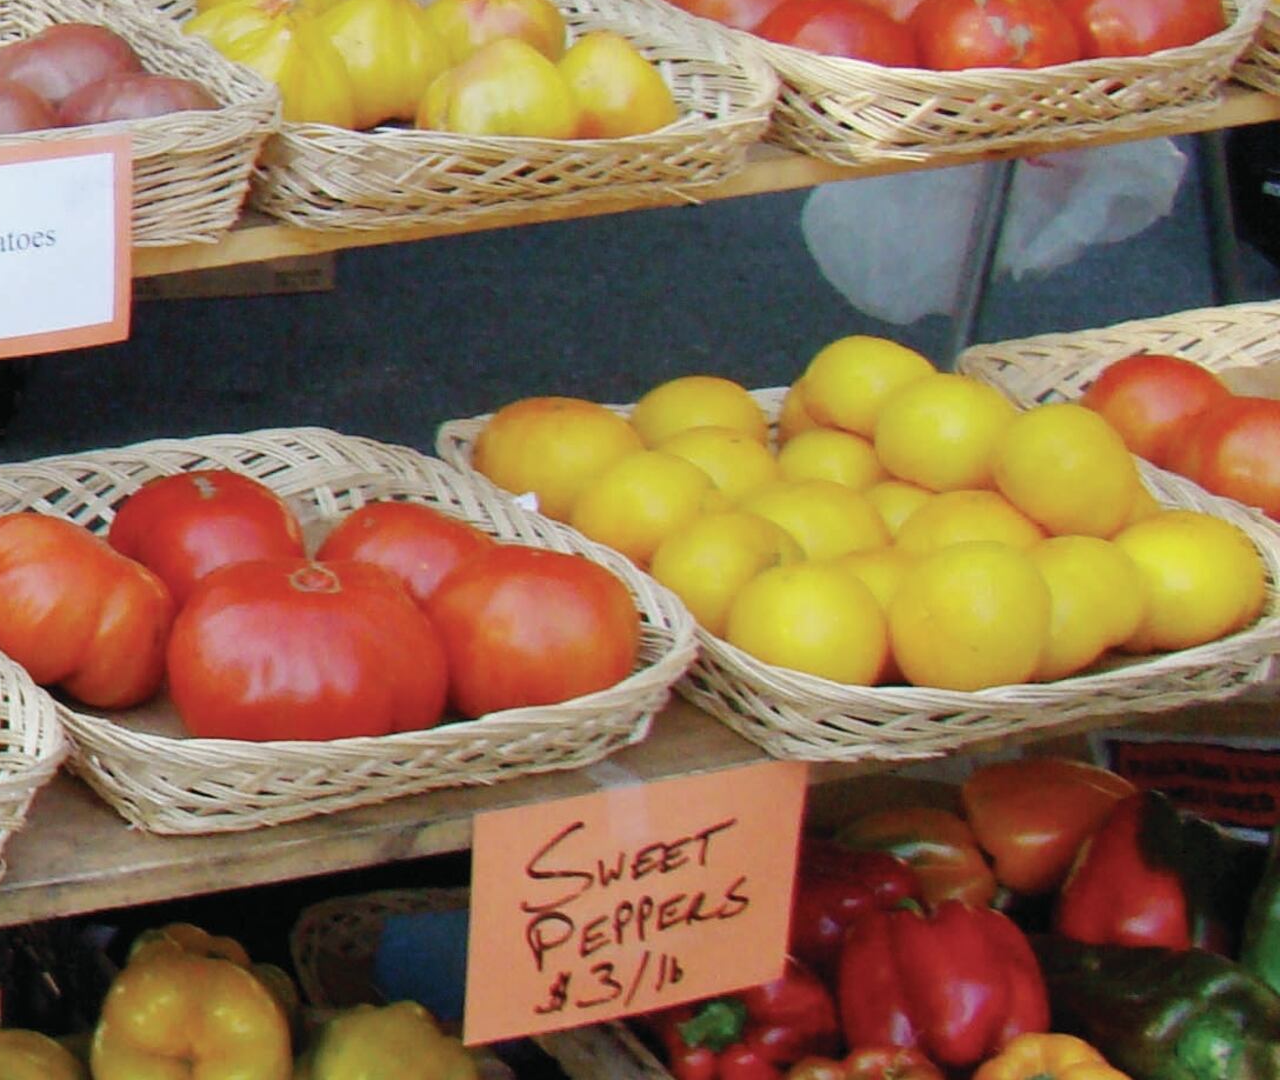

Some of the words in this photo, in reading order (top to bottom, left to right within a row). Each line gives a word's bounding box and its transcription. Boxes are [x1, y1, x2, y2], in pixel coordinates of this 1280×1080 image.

[520, 818, 738, 913] SWEET
[525, 875, 750, 973] PEPPERS
[534, 949, 684, 1014] $3/lb
